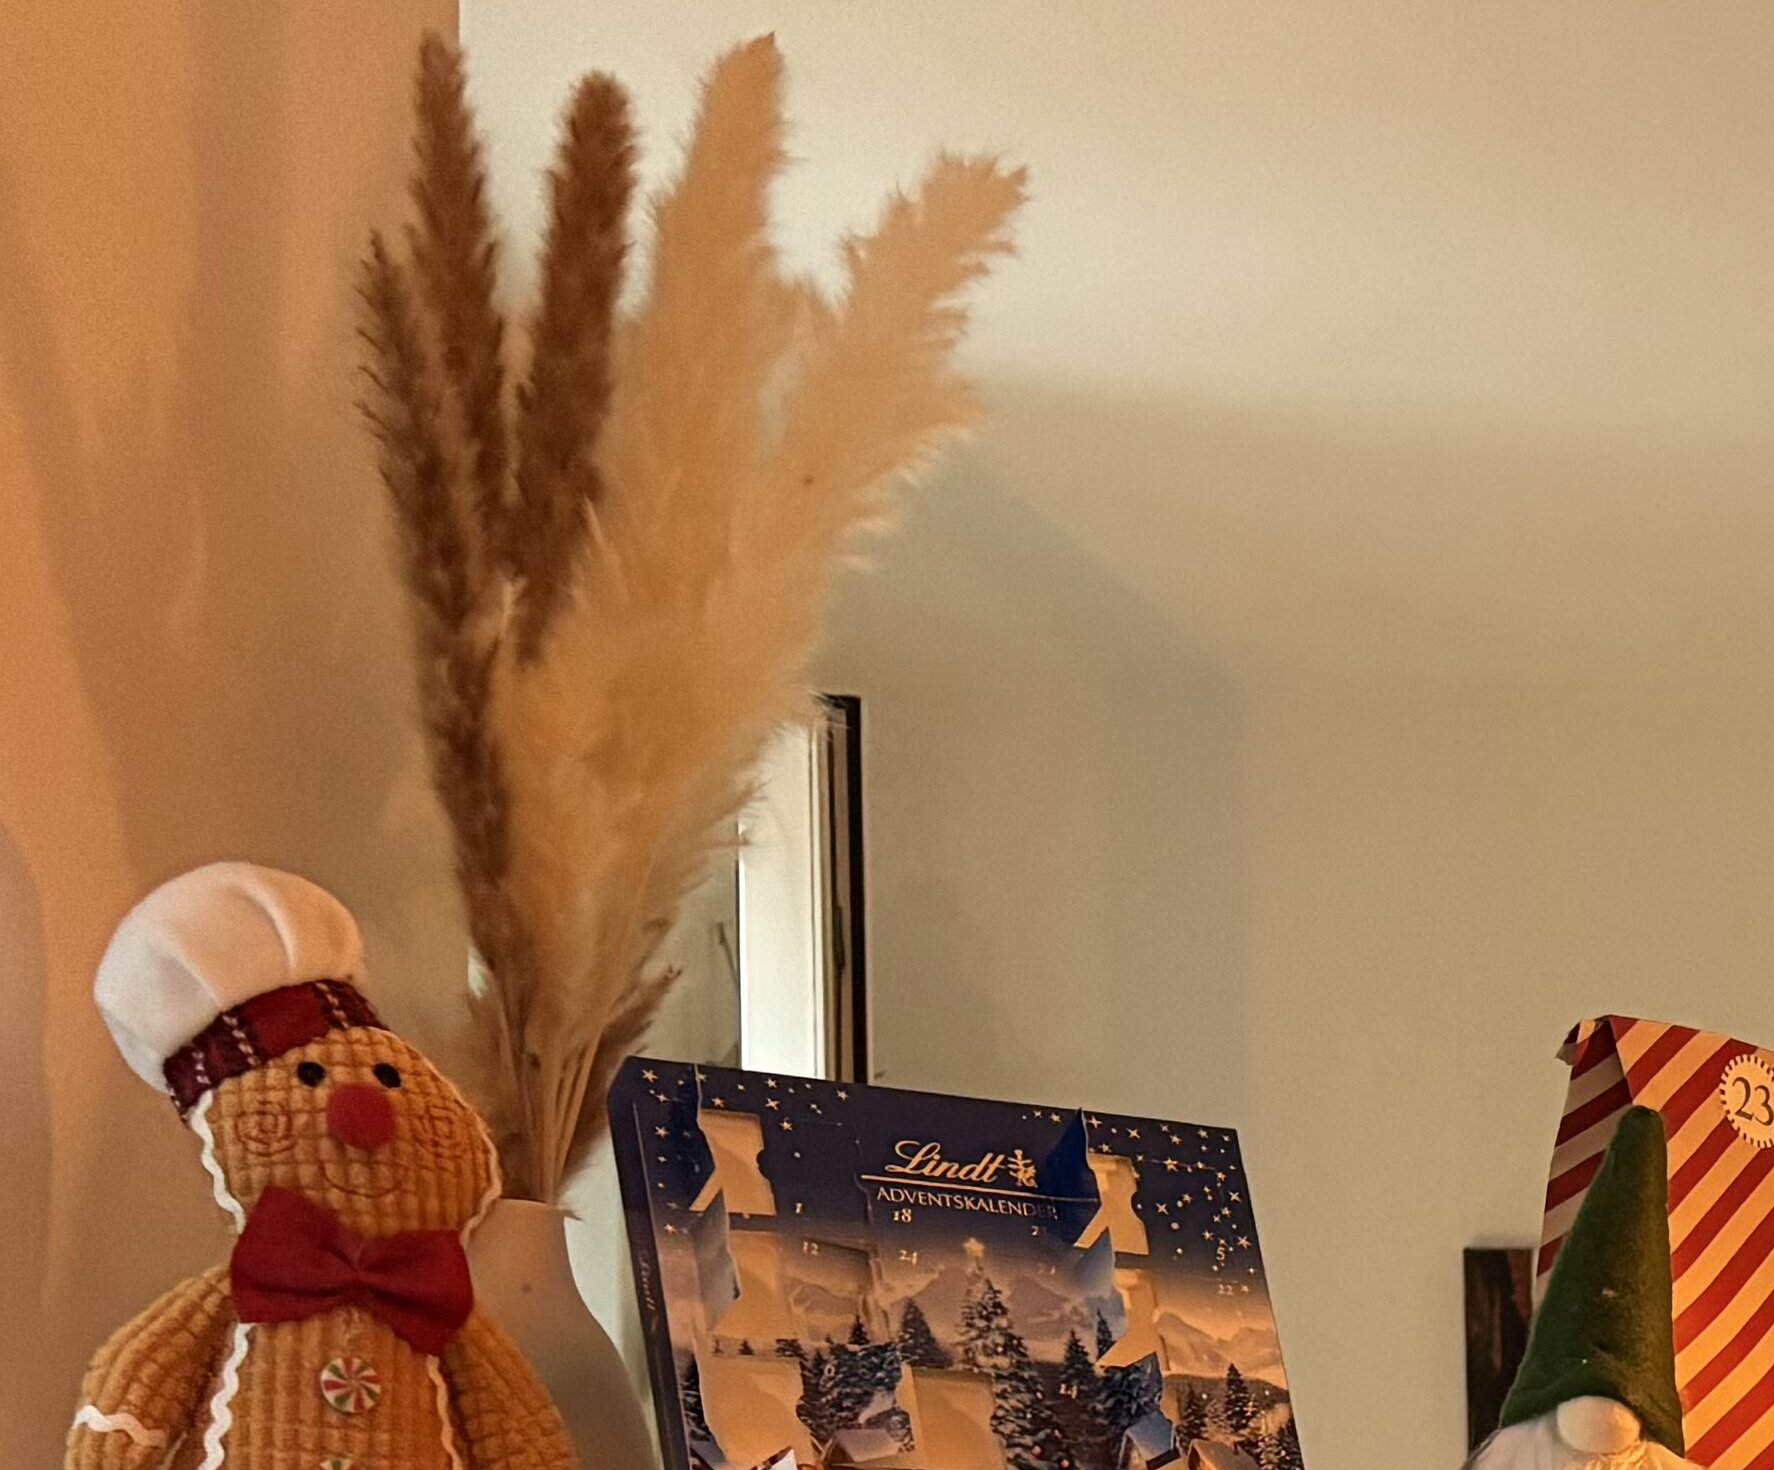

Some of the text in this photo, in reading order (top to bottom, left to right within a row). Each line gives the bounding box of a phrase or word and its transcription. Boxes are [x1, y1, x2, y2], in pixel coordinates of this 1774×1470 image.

[1733, 1076, 1774, 1125] 23
[885, 1140, 1005, 1184] Lindt
[893, 1208, 912, 1223] 18
